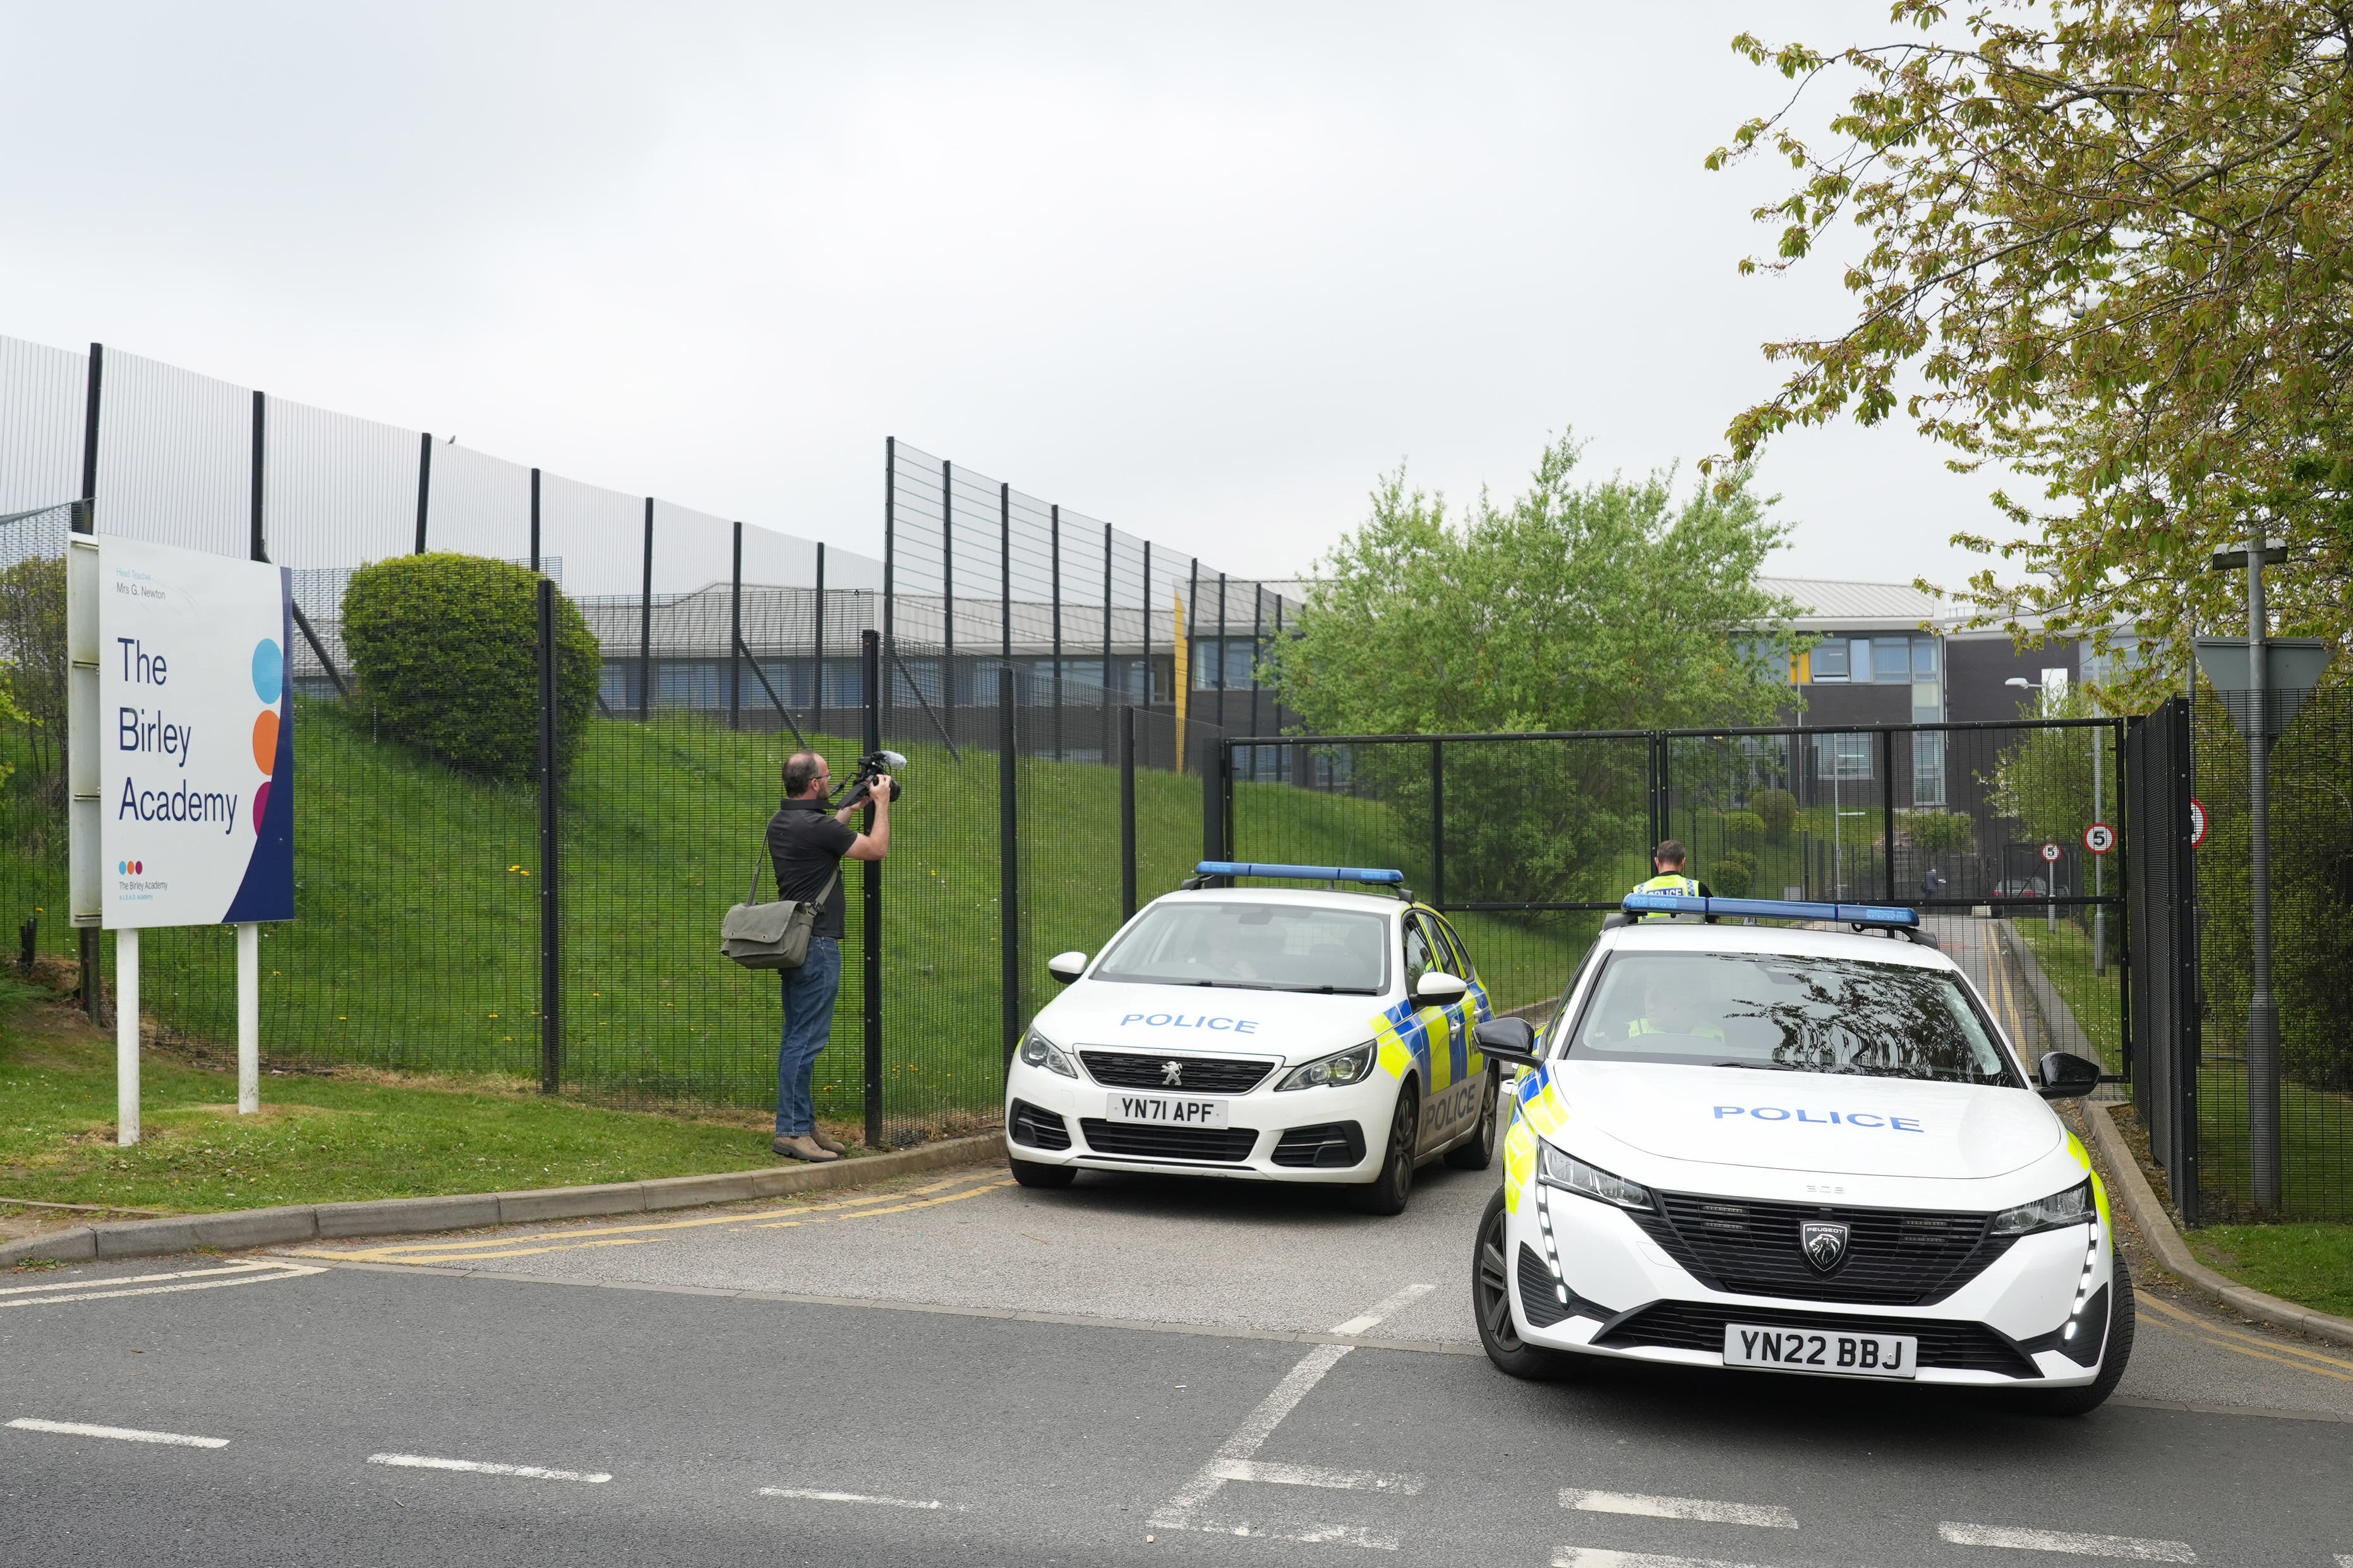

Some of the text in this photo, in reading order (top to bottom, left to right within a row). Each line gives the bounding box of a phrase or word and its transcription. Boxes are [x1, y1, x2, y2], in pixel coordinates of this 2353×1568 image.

[117, 582, 165, 599] Mrs G. Newton
[117, 637, 167, 685] The
[120, 707, 191, 767] Birley
[119, 777, 238, 835] Academy
[2093, 830, 2105, 846] 5
[2047, 847, 2054, 857] 5
[119, 881, 168, 892] The Birley Academy
[1120, 1014, 1259, 1034] POLICE
[1122, 1098, 1214, 1123] YN71 APF
[1424, 1084, 1476, 1131] POLICE
[1713, 1106, 1925, 1133] POLICE
[1741, 1331, 1901, 1370] YN22 BBJ
